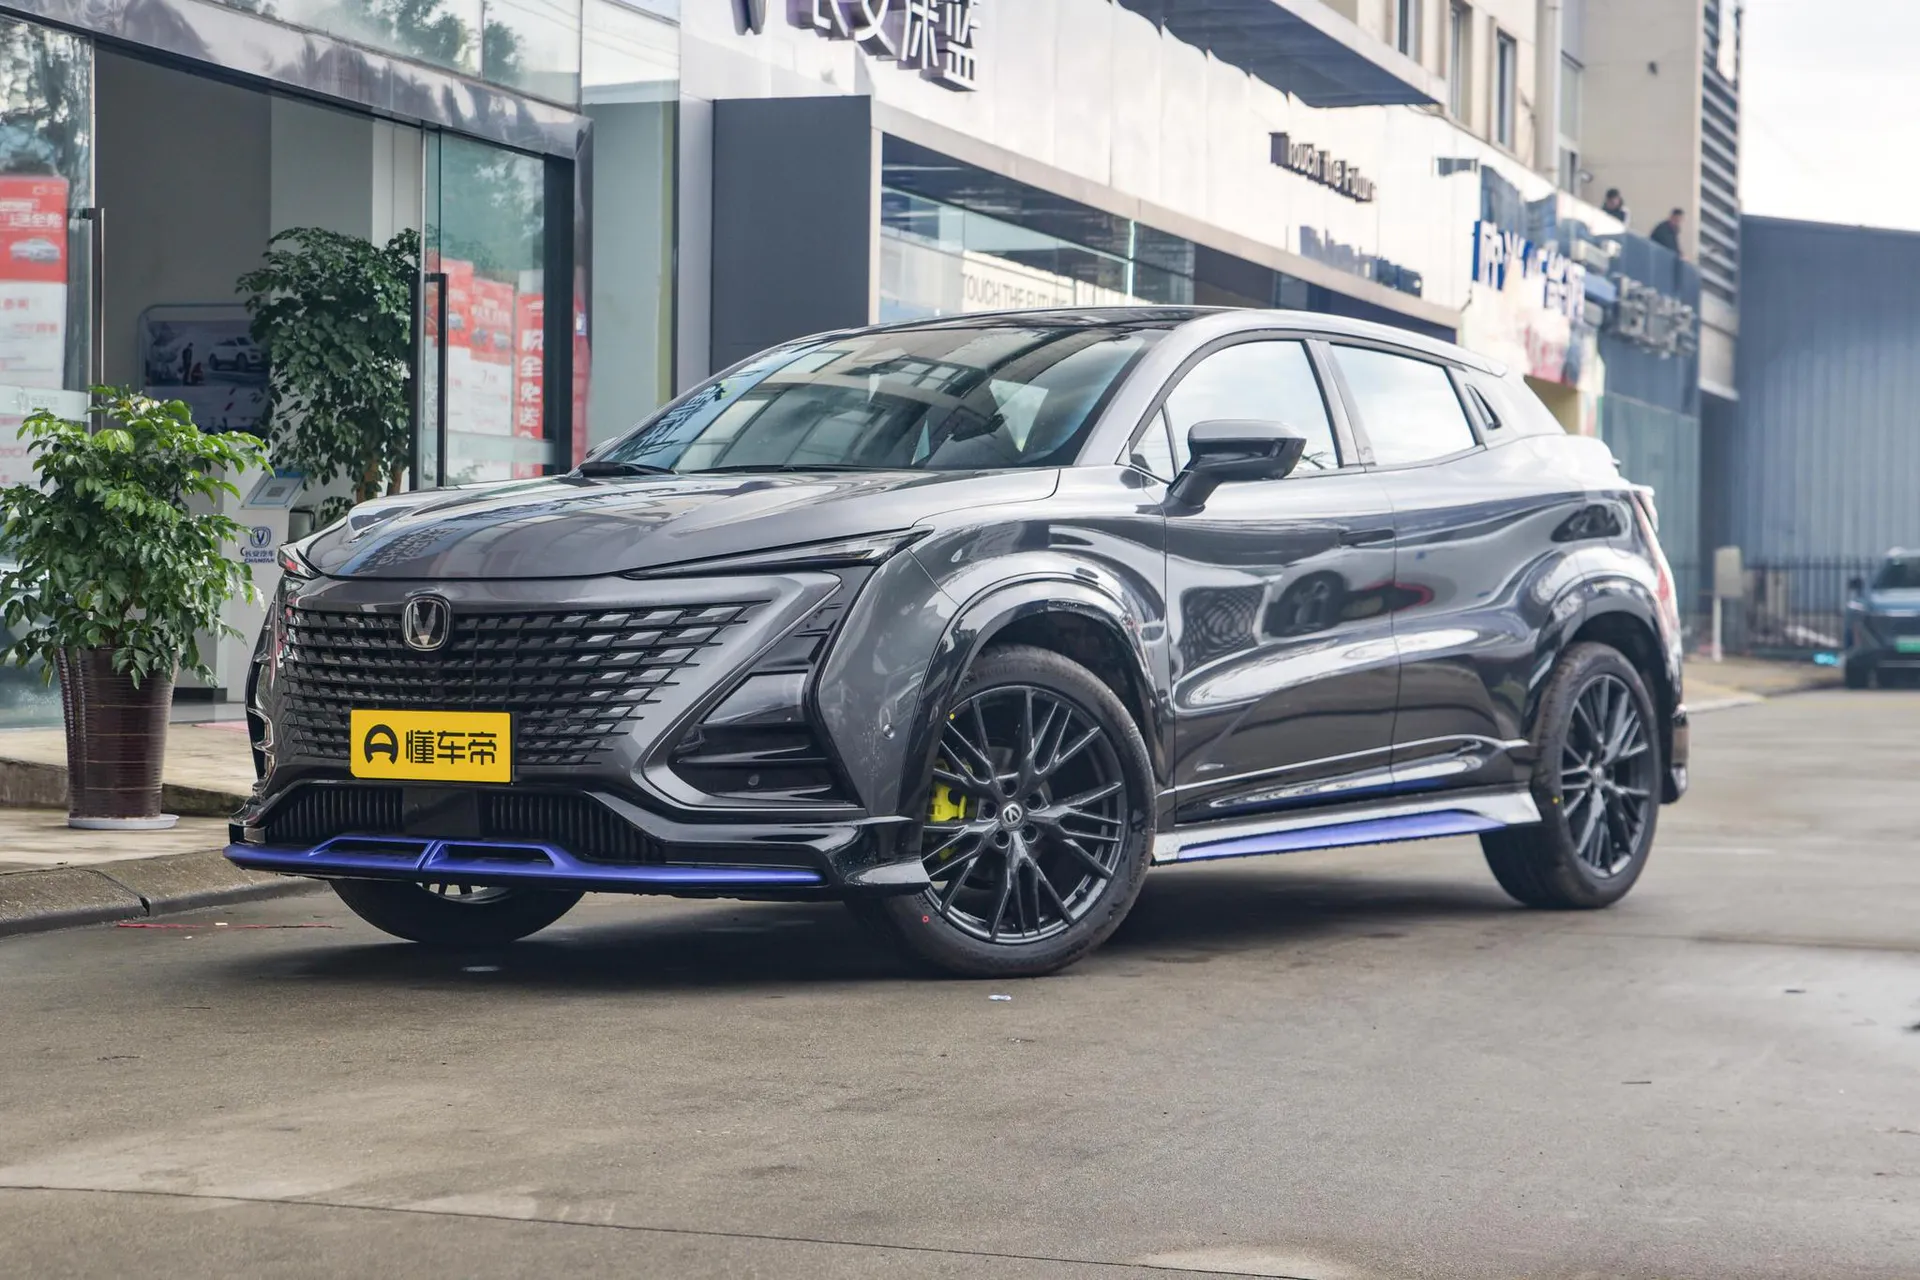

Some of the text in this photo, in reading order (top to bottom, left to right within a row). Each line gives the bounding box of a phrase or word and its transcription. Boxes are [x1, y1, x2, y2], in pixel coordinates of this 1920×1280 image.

[961, 272, 1000, 308] TOUCH
[1002, 283, 1025, 308] THE
[406, 730, 497, 765] 懂车帝
